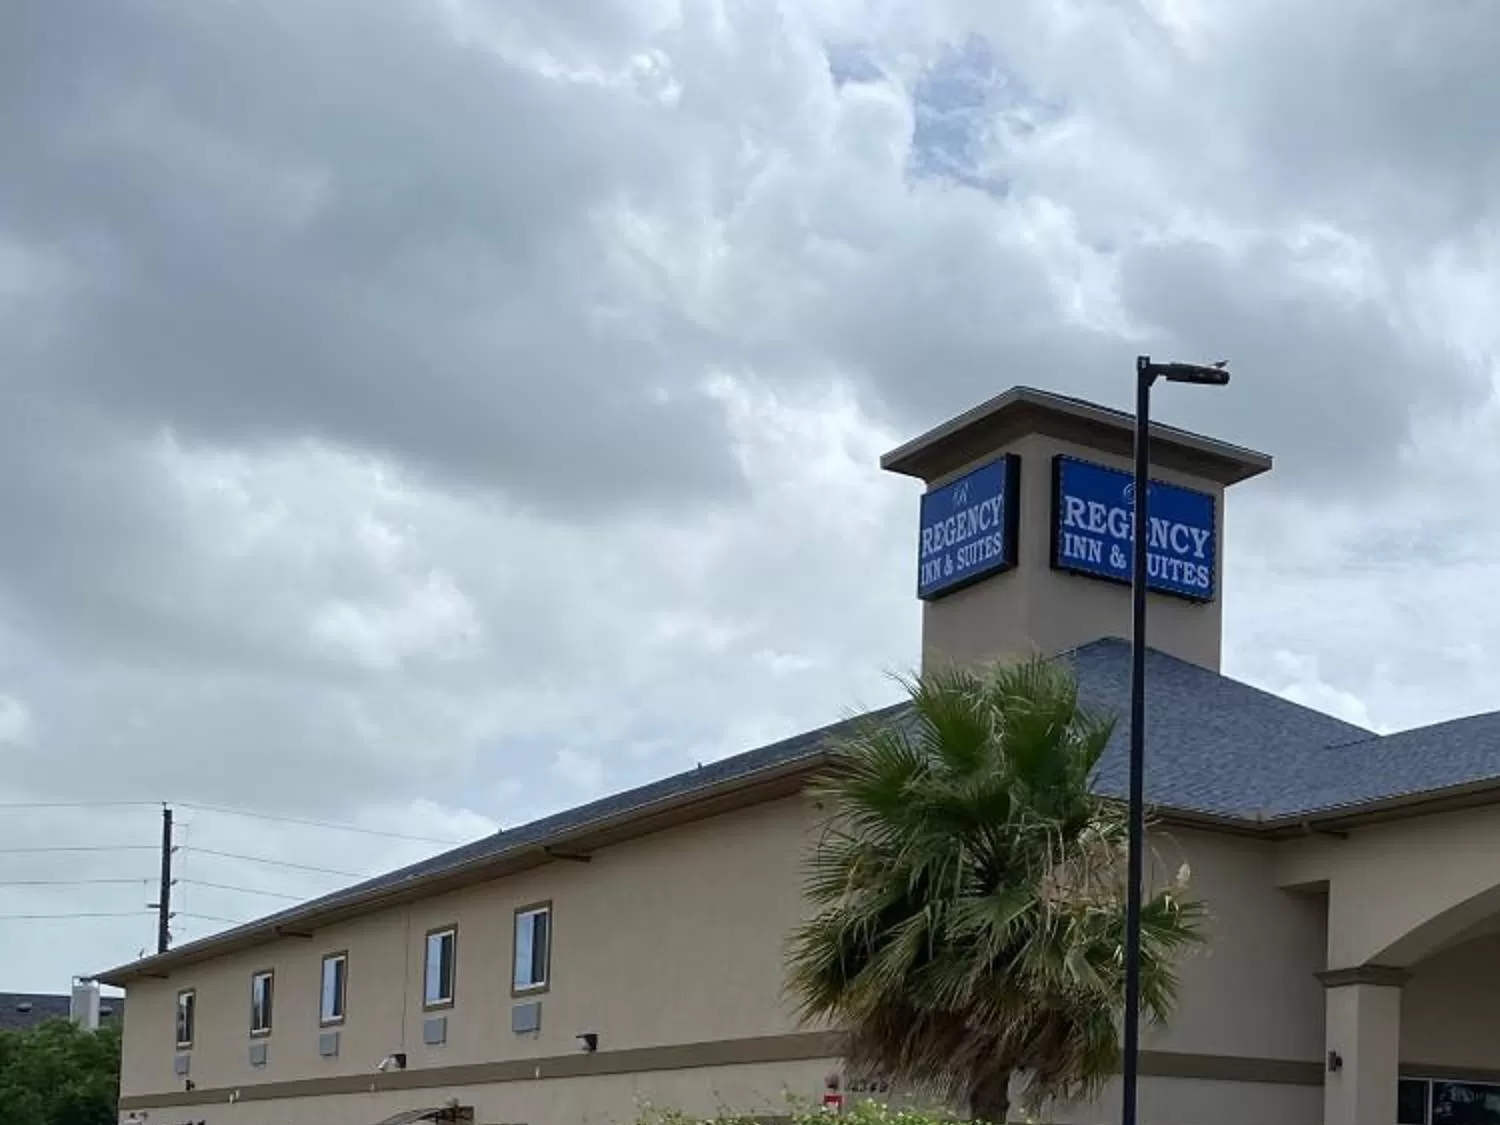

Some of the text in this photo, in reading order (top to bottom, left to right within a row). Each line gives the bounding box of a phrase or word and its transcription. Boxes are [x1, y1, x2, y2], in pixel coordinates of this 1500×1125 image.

[922, 493, 1003, 559] REGENCY
[921, 532, 1002, 586] INN & SUITES
[1063, 532, 1209, 589] INN & UITES
